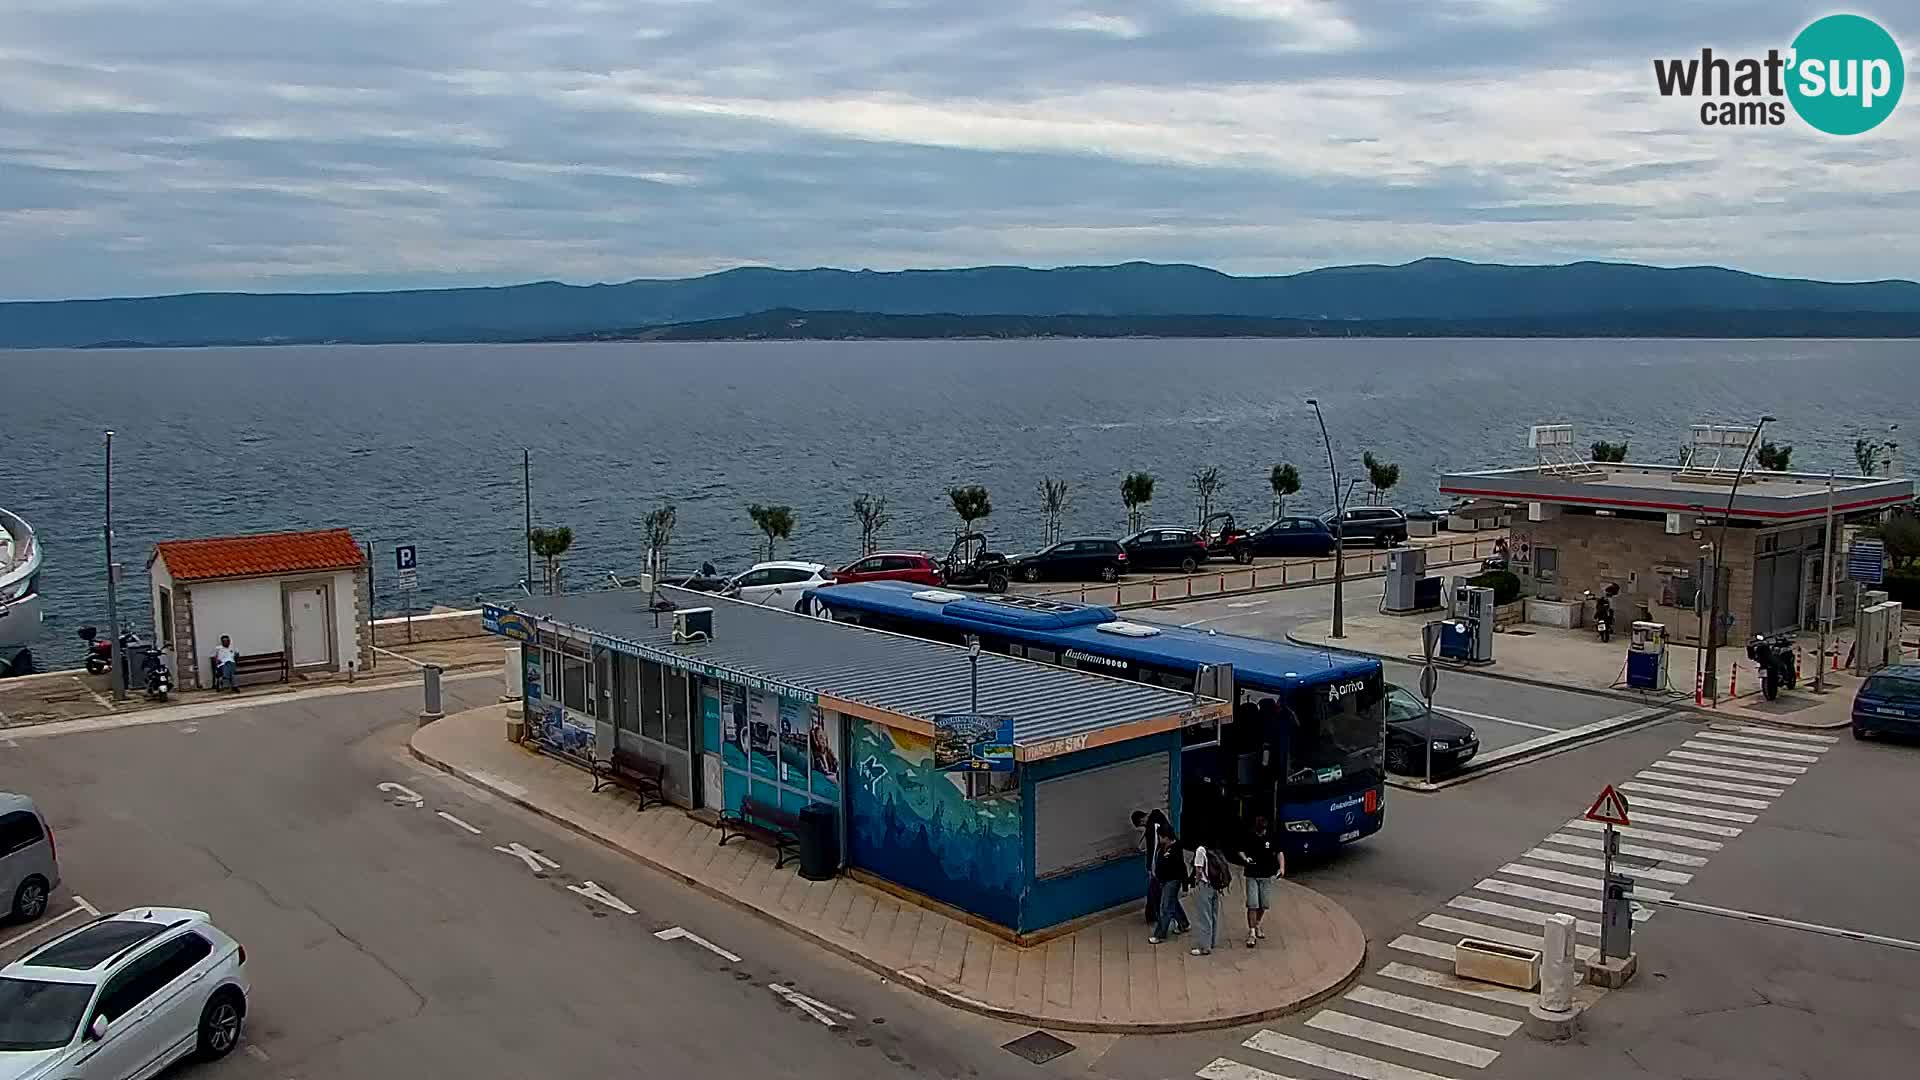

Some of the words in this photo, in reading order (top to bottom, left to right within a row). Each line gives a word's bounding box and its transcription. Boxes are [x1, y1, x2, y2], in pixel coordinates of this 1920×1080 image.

[400, 548, 412, 566] P
[676, 658, 706, 674] POSTAJA
[715, 668, 730, 681] BUS
[730, 673, 761, 689] STATION
[763, 681, 787, 697] TICKET
[788, 688, 815, 703] OFFICE
